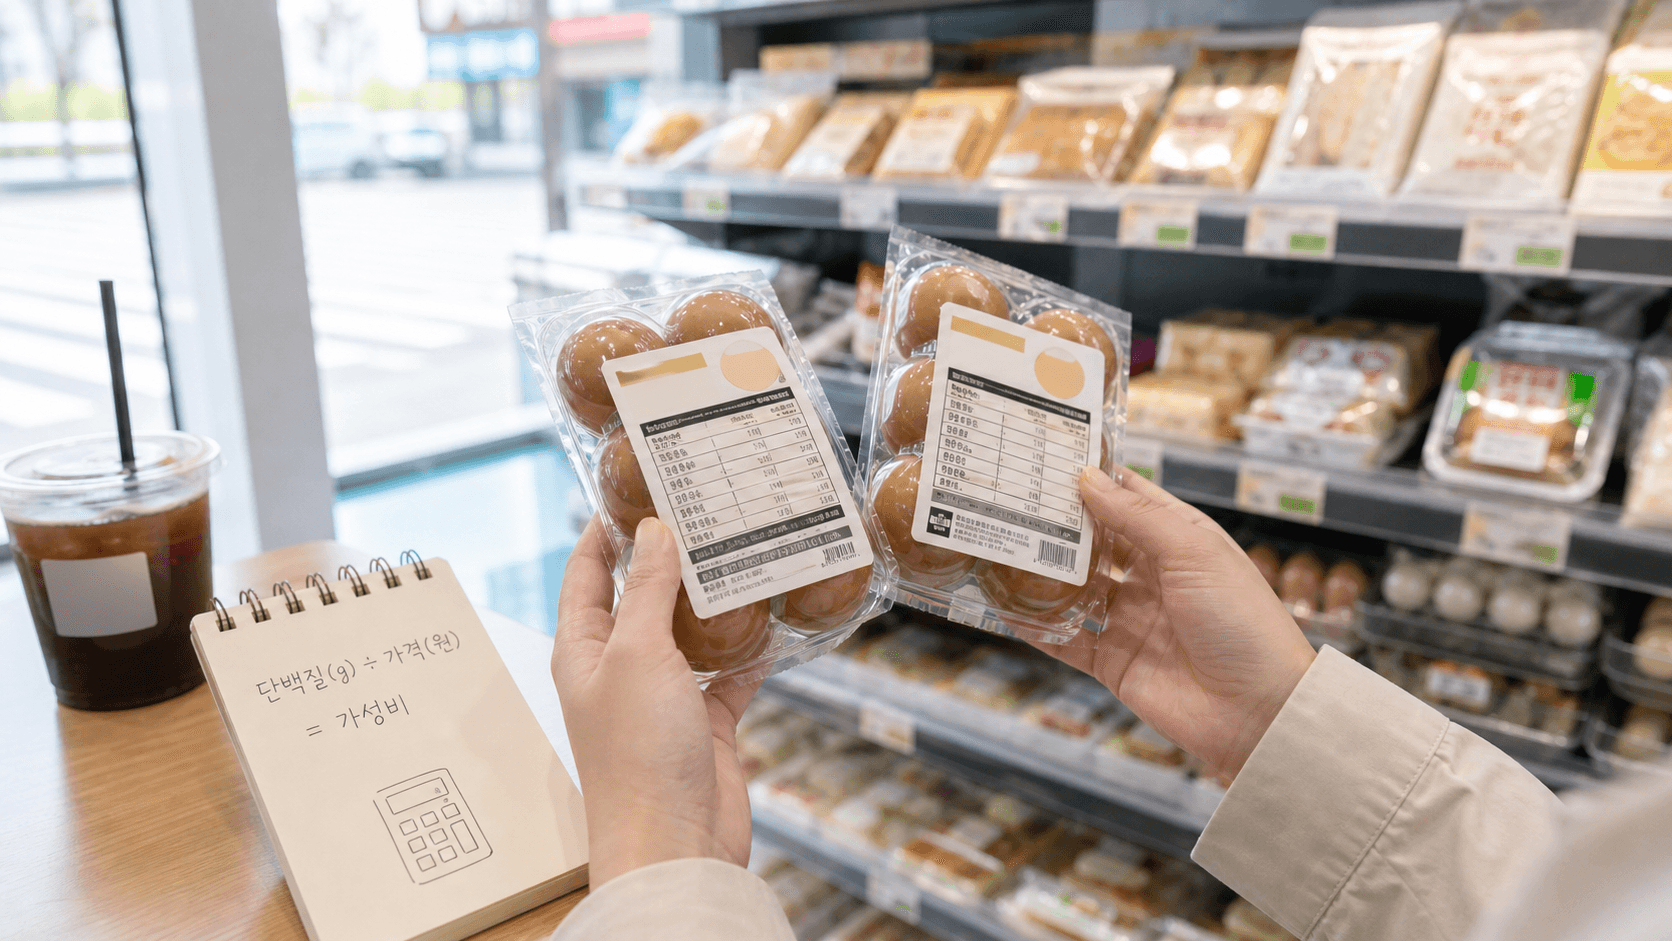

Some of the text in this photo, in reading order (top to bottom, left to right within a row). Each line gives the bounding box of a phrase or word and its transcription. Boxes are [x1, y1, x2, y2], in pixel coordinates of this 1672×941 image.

[255, 659, 357, 703] 단백질(g)
[383, 630, 461, 665] 가격(원)
[335, 694, 410, 730] 가성비
